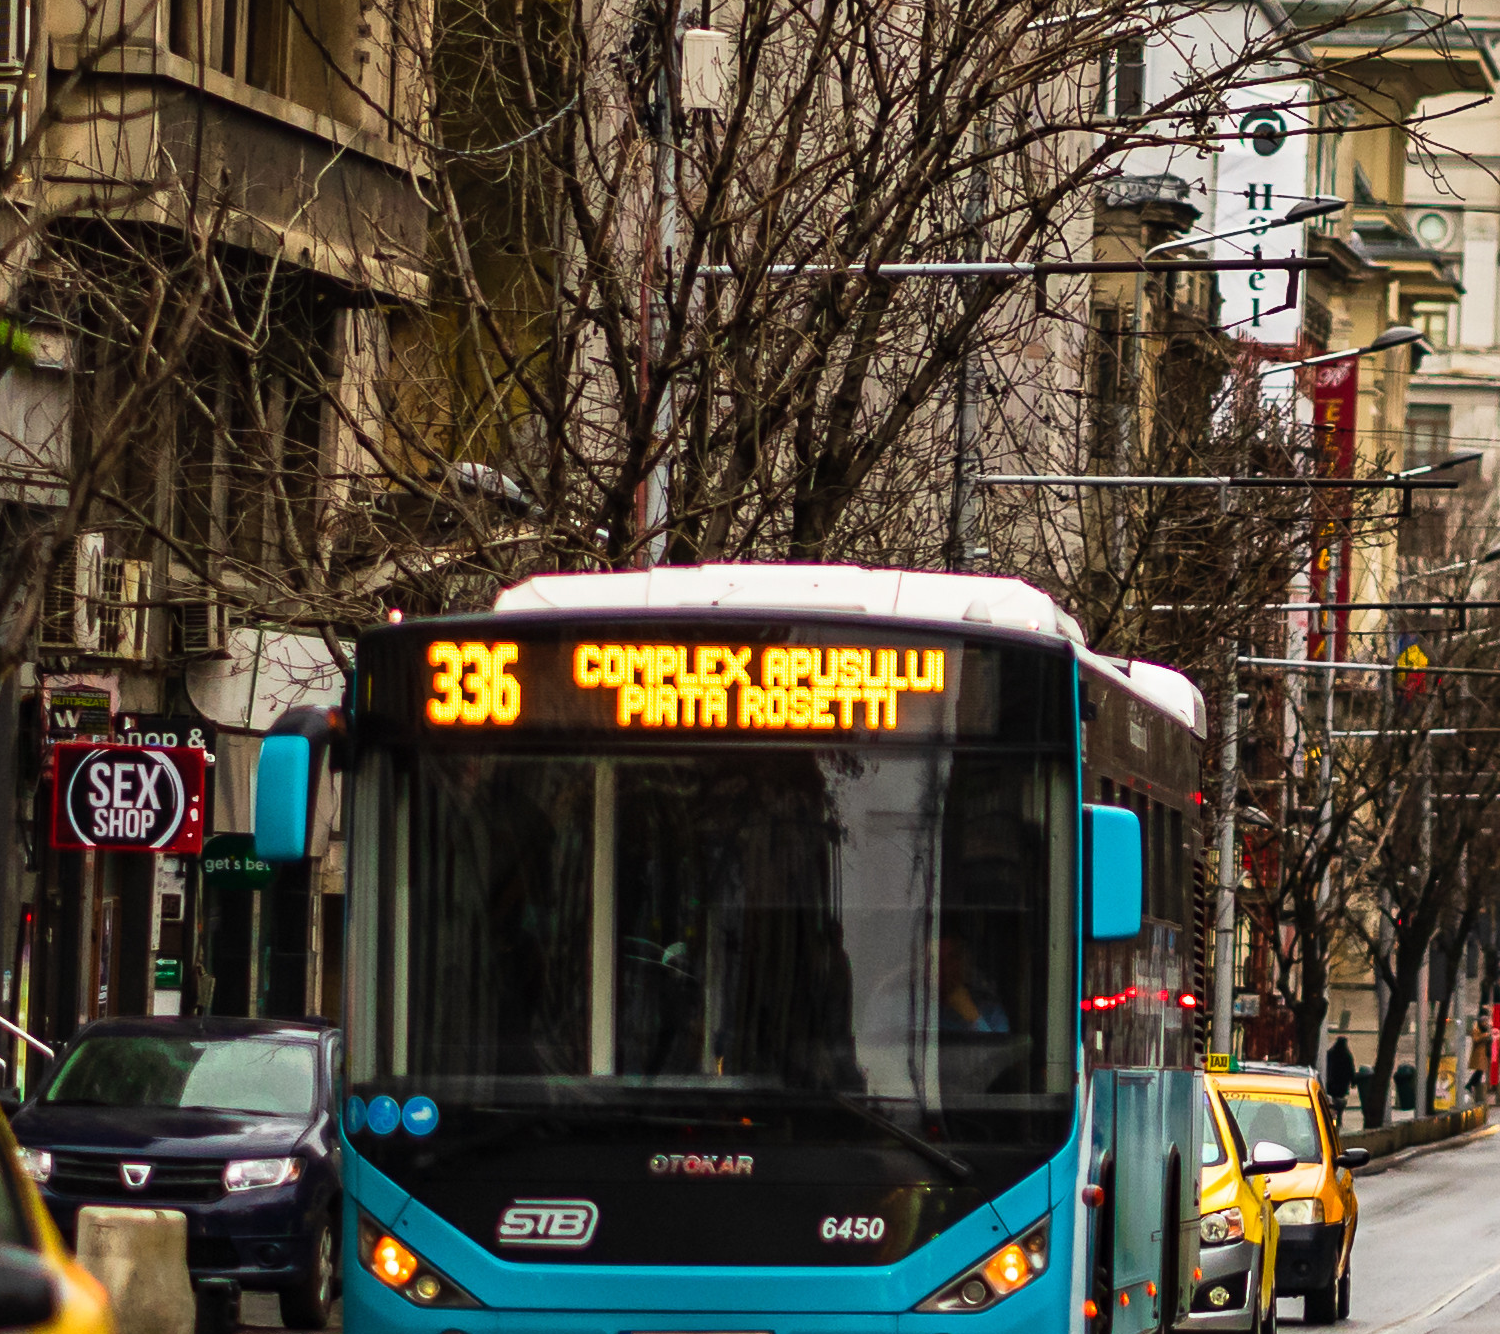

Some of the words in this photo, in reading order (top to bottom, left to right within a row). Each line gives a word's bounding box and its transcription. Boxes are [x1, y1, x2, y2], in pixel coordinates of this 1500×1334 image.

[427, 642, 521, 724] 336
[574, 645, 752, 688] COMPLEX
[761, 647, 945, 691] APUSULUI
[617, 685, 727, 727] PIATA
[737, 686, 899, 729] ROSETTI
[187, 728, 206, 749] &
[88, 762, 162, 810] SEX
[93, 808, 156, 839] SHOP
[650, 1154, 754, 1175] OTOKAR
[500, 1208, 588, 1237] STB
[821, 1216, 885, 1241] 6450
